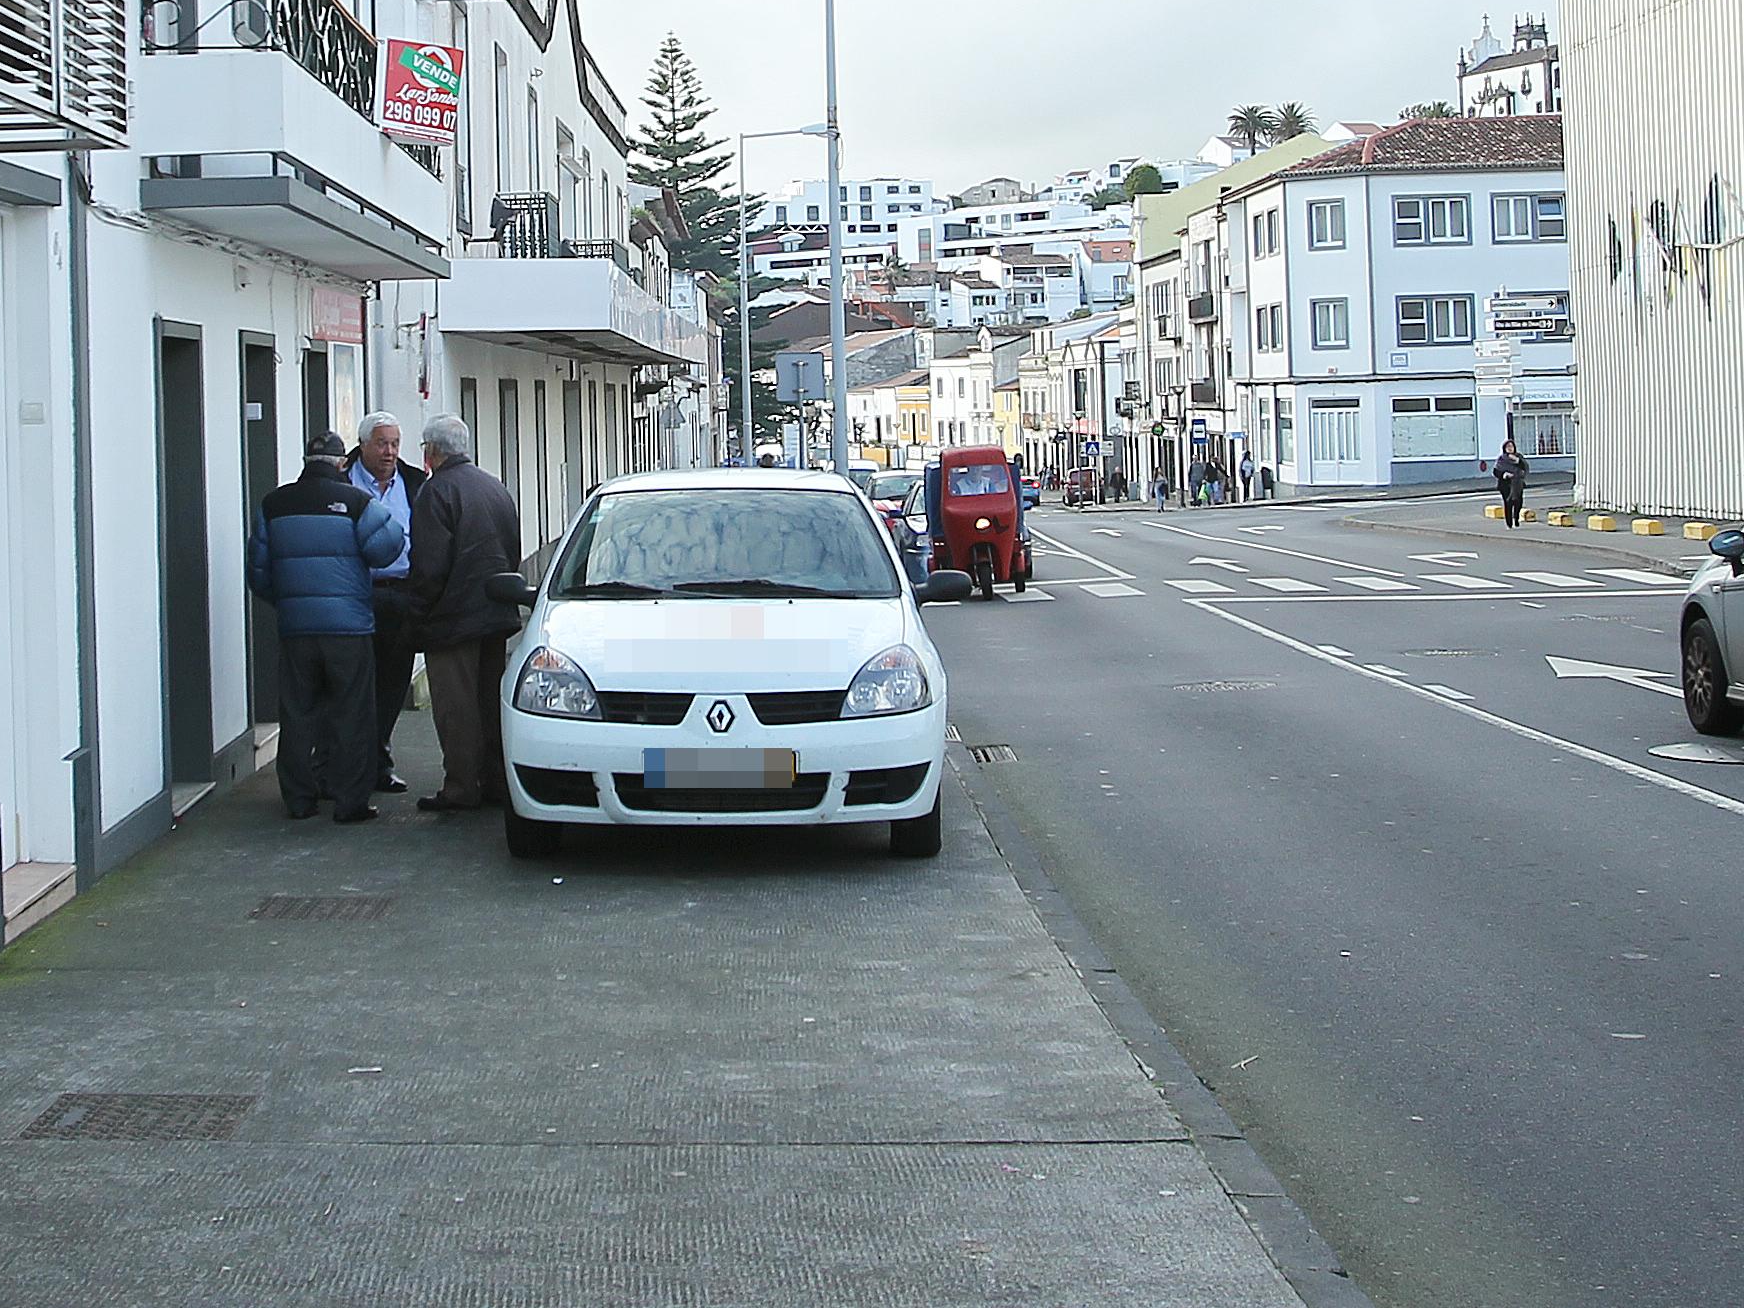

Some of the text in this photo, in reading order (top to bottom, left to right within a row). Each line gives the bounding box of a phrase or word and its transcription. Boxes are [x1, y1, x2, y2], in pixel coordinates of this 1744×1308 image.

[412, 54, 458, 89] VENDE
[385, 100, 412, 122] 296
[414, 104, 441, 127] 099
